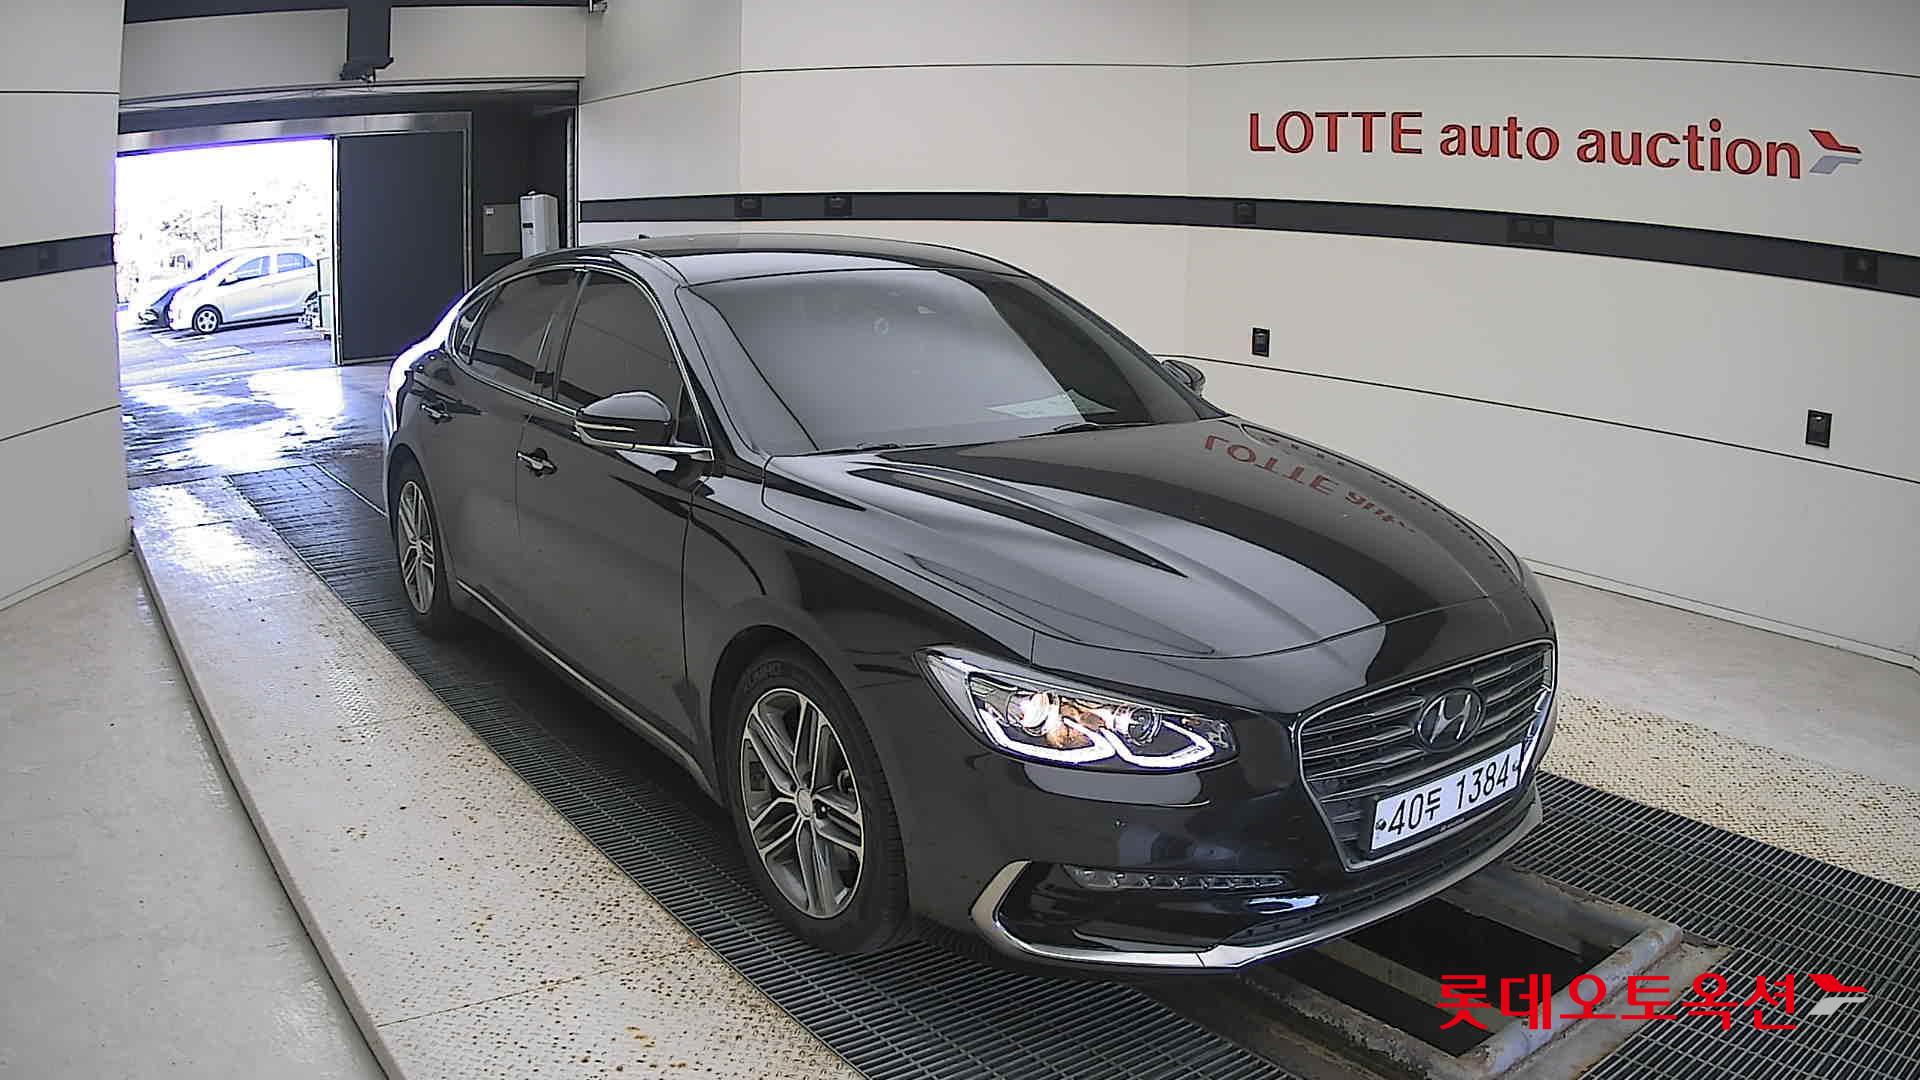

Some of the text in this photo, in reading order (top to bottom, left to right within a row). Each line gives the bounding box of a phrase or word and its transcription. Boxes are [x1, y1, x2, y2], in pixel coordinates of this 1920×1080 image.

[1249, 111, 1801, 179] LOTTE auto auction
[1388, 754, 1510, 835] 40두 1384
